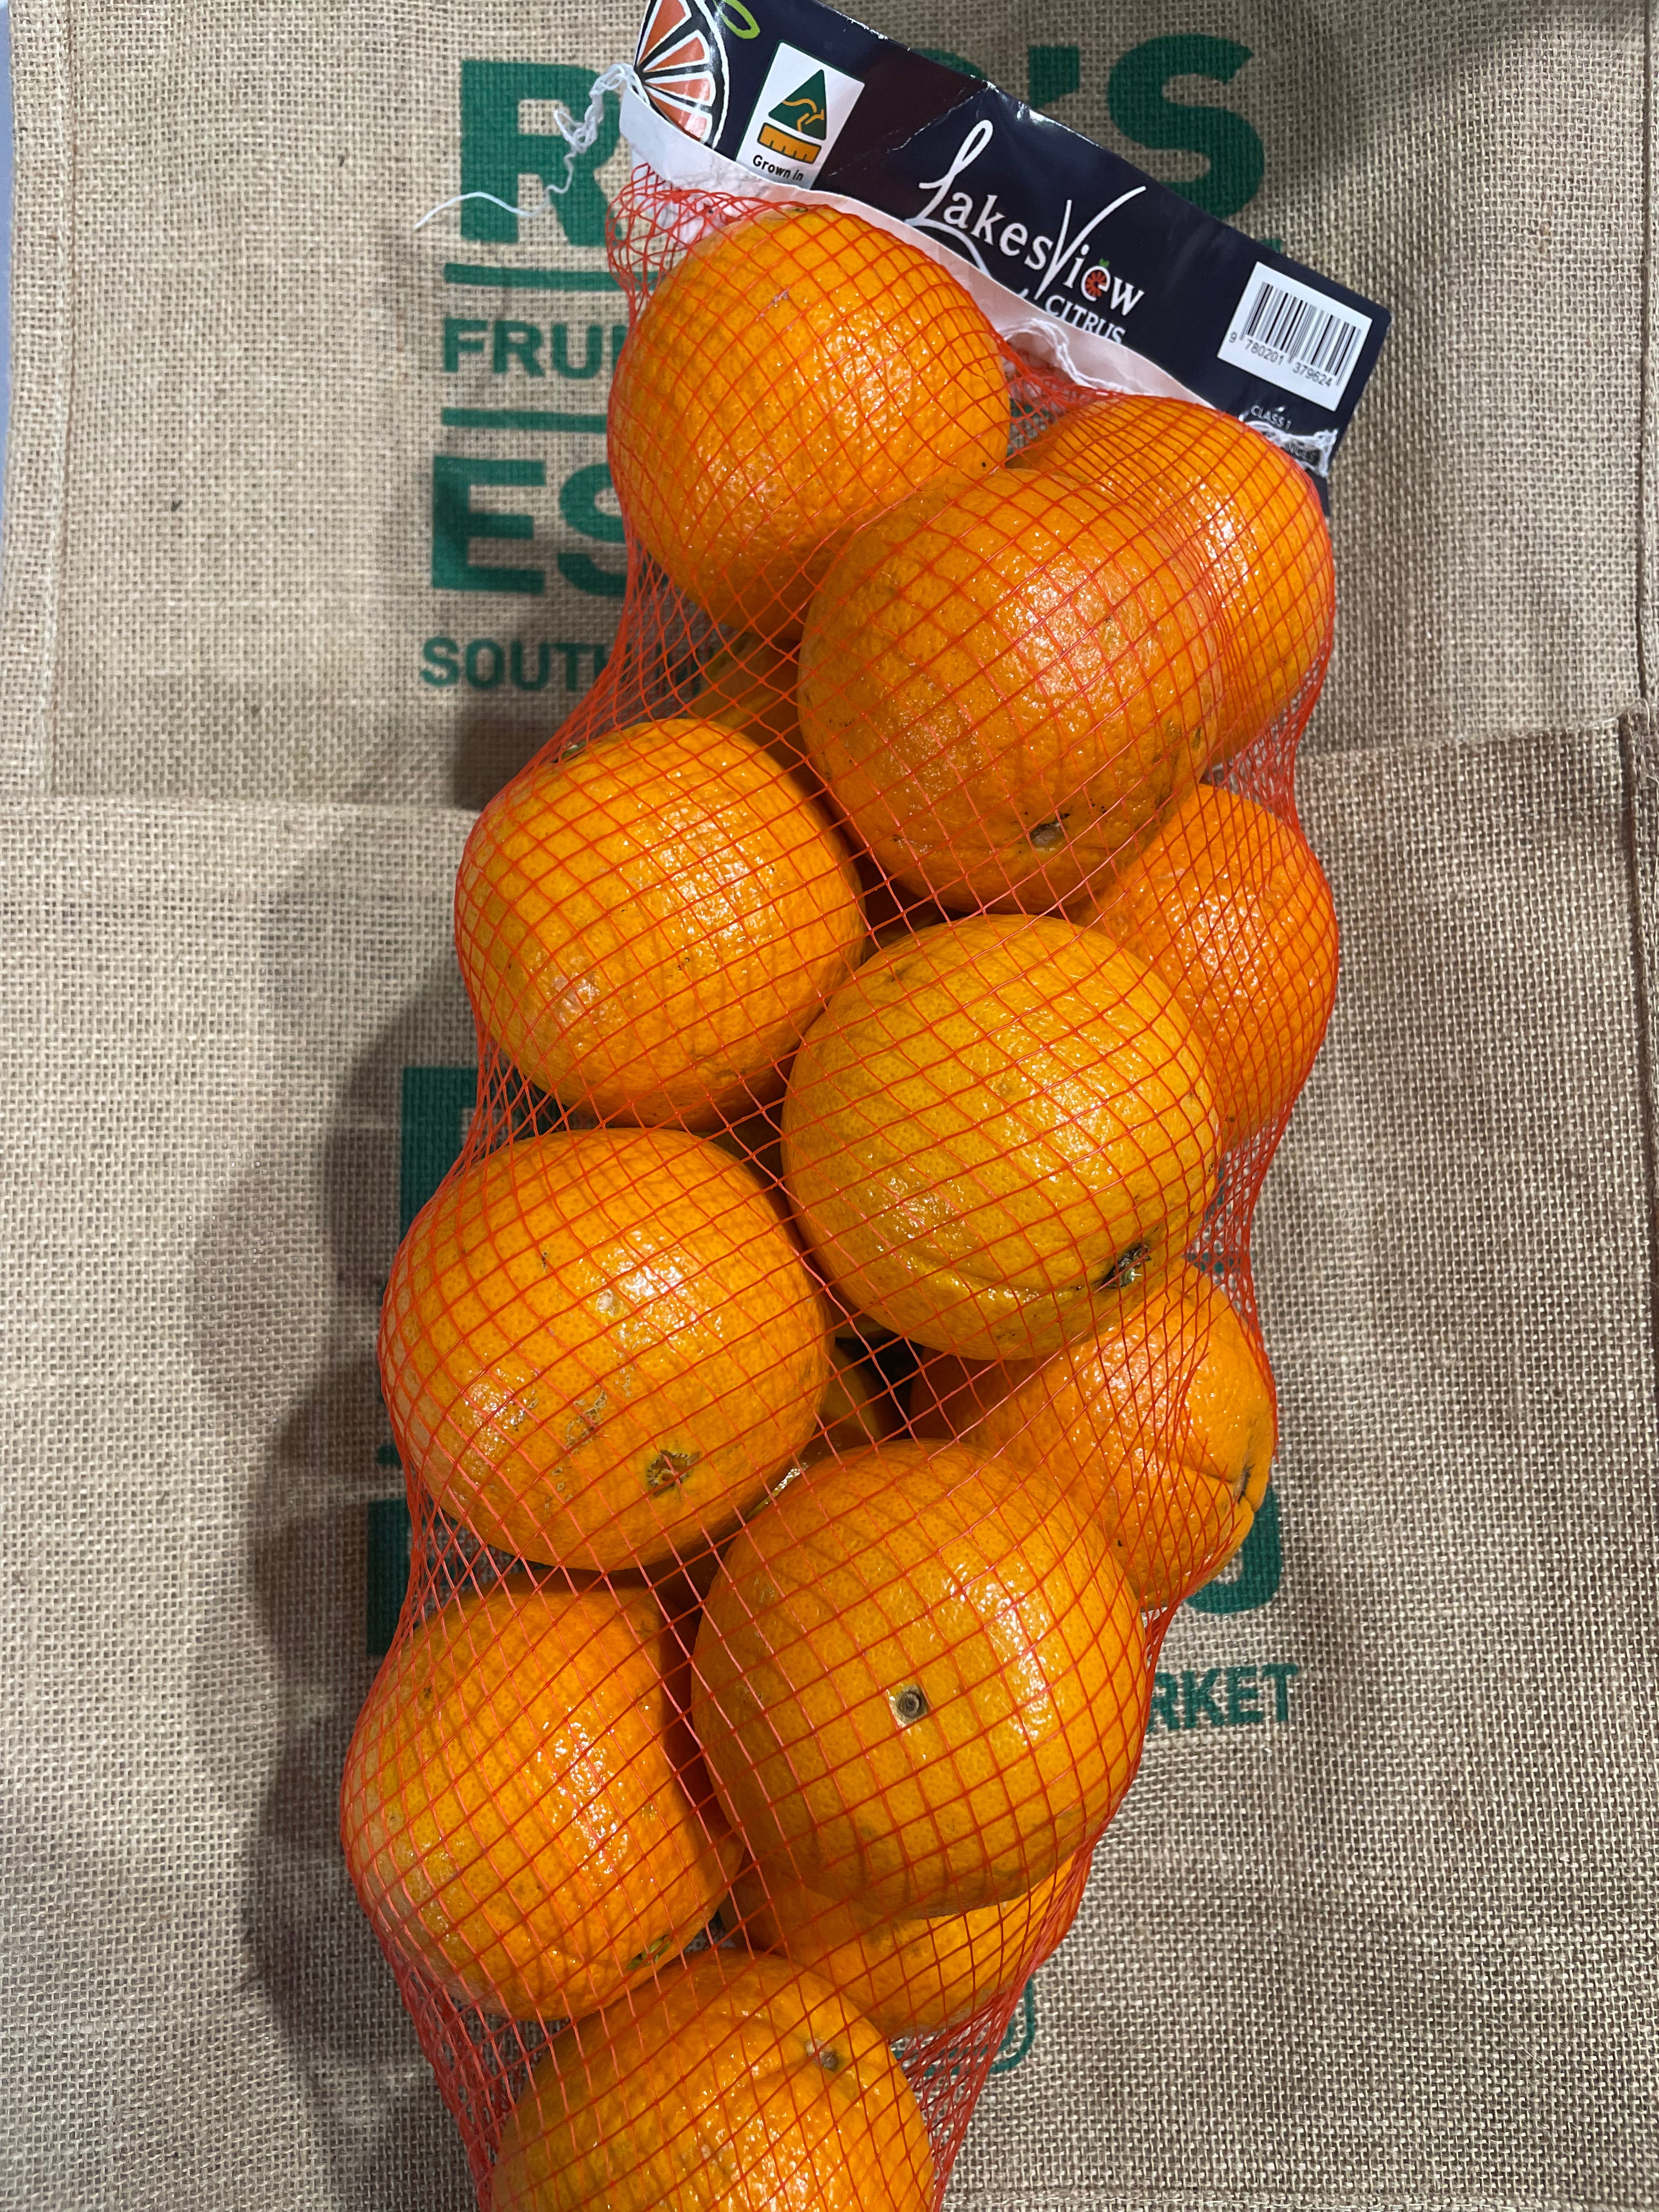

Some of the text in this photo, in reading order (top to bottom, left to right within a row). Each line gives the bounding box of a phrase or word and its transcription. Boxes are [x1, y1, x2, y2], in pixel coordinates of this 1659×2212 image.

[753, 154, 791, 178] Grown
[1045, 294, 1126, 345] CITRUS
[444, 317, 629, 379] FRUI
[1229, 331, 1333, 388] 9 780201 379624
[1251, 405, 1285, 428] CLASS
[1146, 1662, 1299, 1734] RKET
